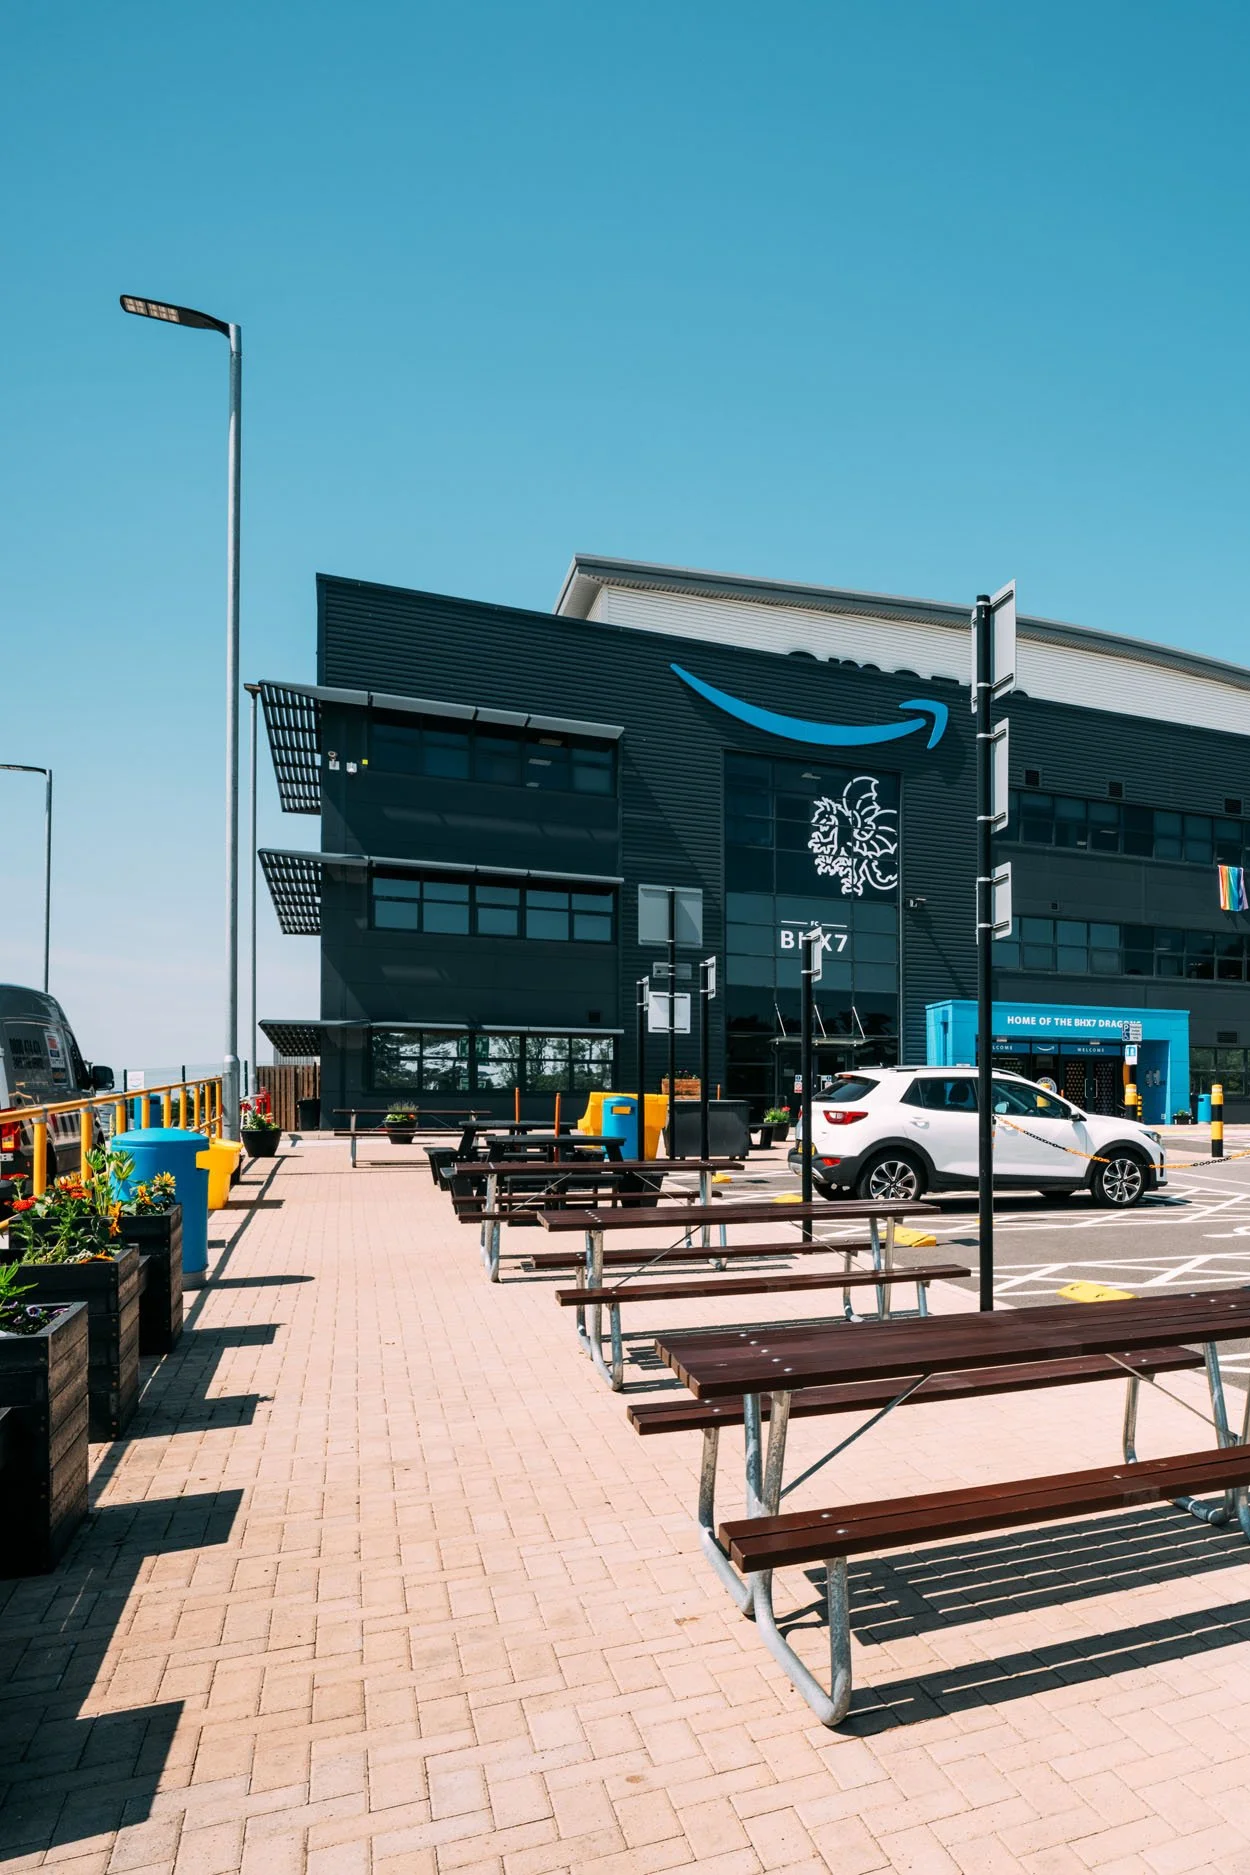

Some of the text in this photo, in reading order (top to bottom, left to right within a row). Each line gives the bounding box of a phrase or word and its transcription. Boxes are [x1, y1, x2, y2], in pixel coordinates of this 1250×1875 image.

[1007, 1016, 1036, 1025] HOME
[1039, 1017, 1052, 1026] OF
[1054, 1018, 1073, 1027] THE
[1074, 1018, 1098, 1028] BHX7
